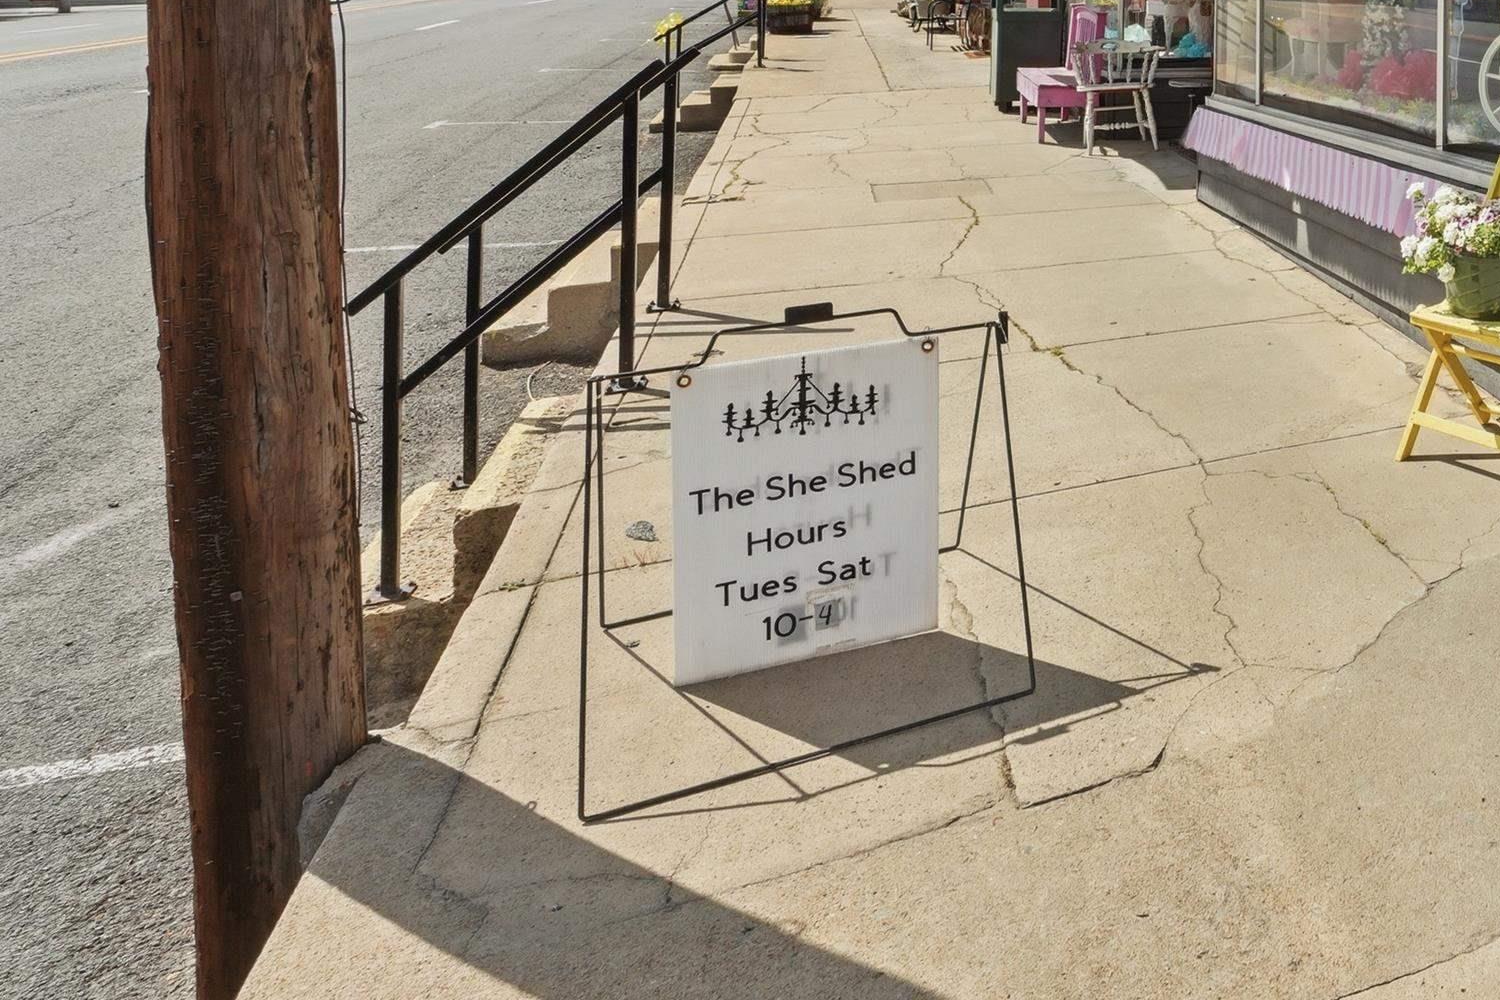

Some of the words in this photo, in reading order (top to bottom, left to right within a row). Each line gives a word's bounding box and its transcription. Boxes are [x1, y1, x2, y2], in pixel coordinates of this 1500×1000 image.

[689, 486, 755, 516] The
[766, 473, 827, 501] She
[837, 450, 917, 488] Shed
[747, 519, 847, 557] Hours
[715, 575, 798, 607] Tues
[817, 556, 871, 586] Sat
[762, 604, 833, 641] 10-4
